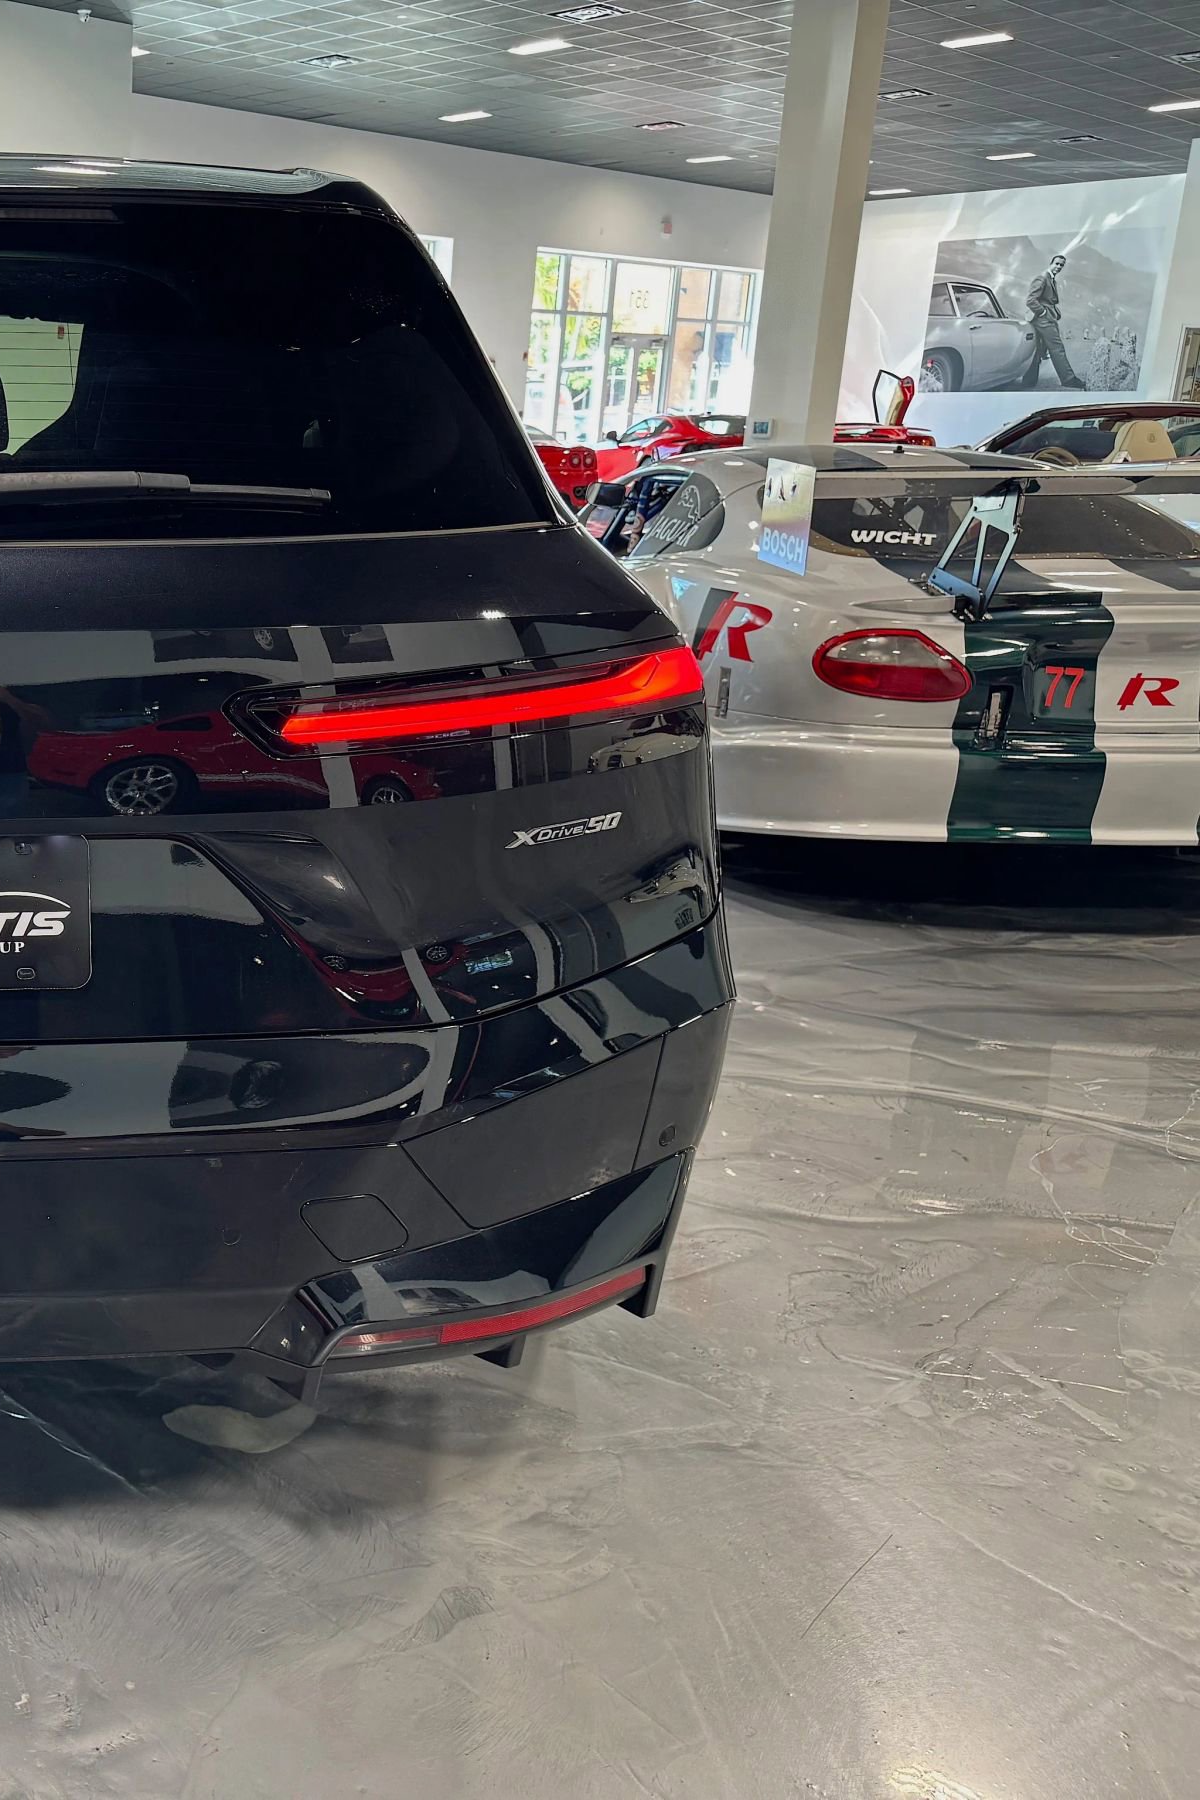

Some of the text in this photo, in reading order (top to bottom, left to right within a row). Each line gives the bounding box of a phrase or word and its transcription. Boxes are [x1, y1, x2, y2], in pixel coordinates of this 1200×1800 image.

[645, 516, 699, 547] JAGUAR
[762, 527, 804, 562] BOSCH
[850, 529, 937, 546] WICHT
[696, 592, 773, 663] R
[1045, 666, 1085, 709] 77
[1117, 673, 1180, 711] R
